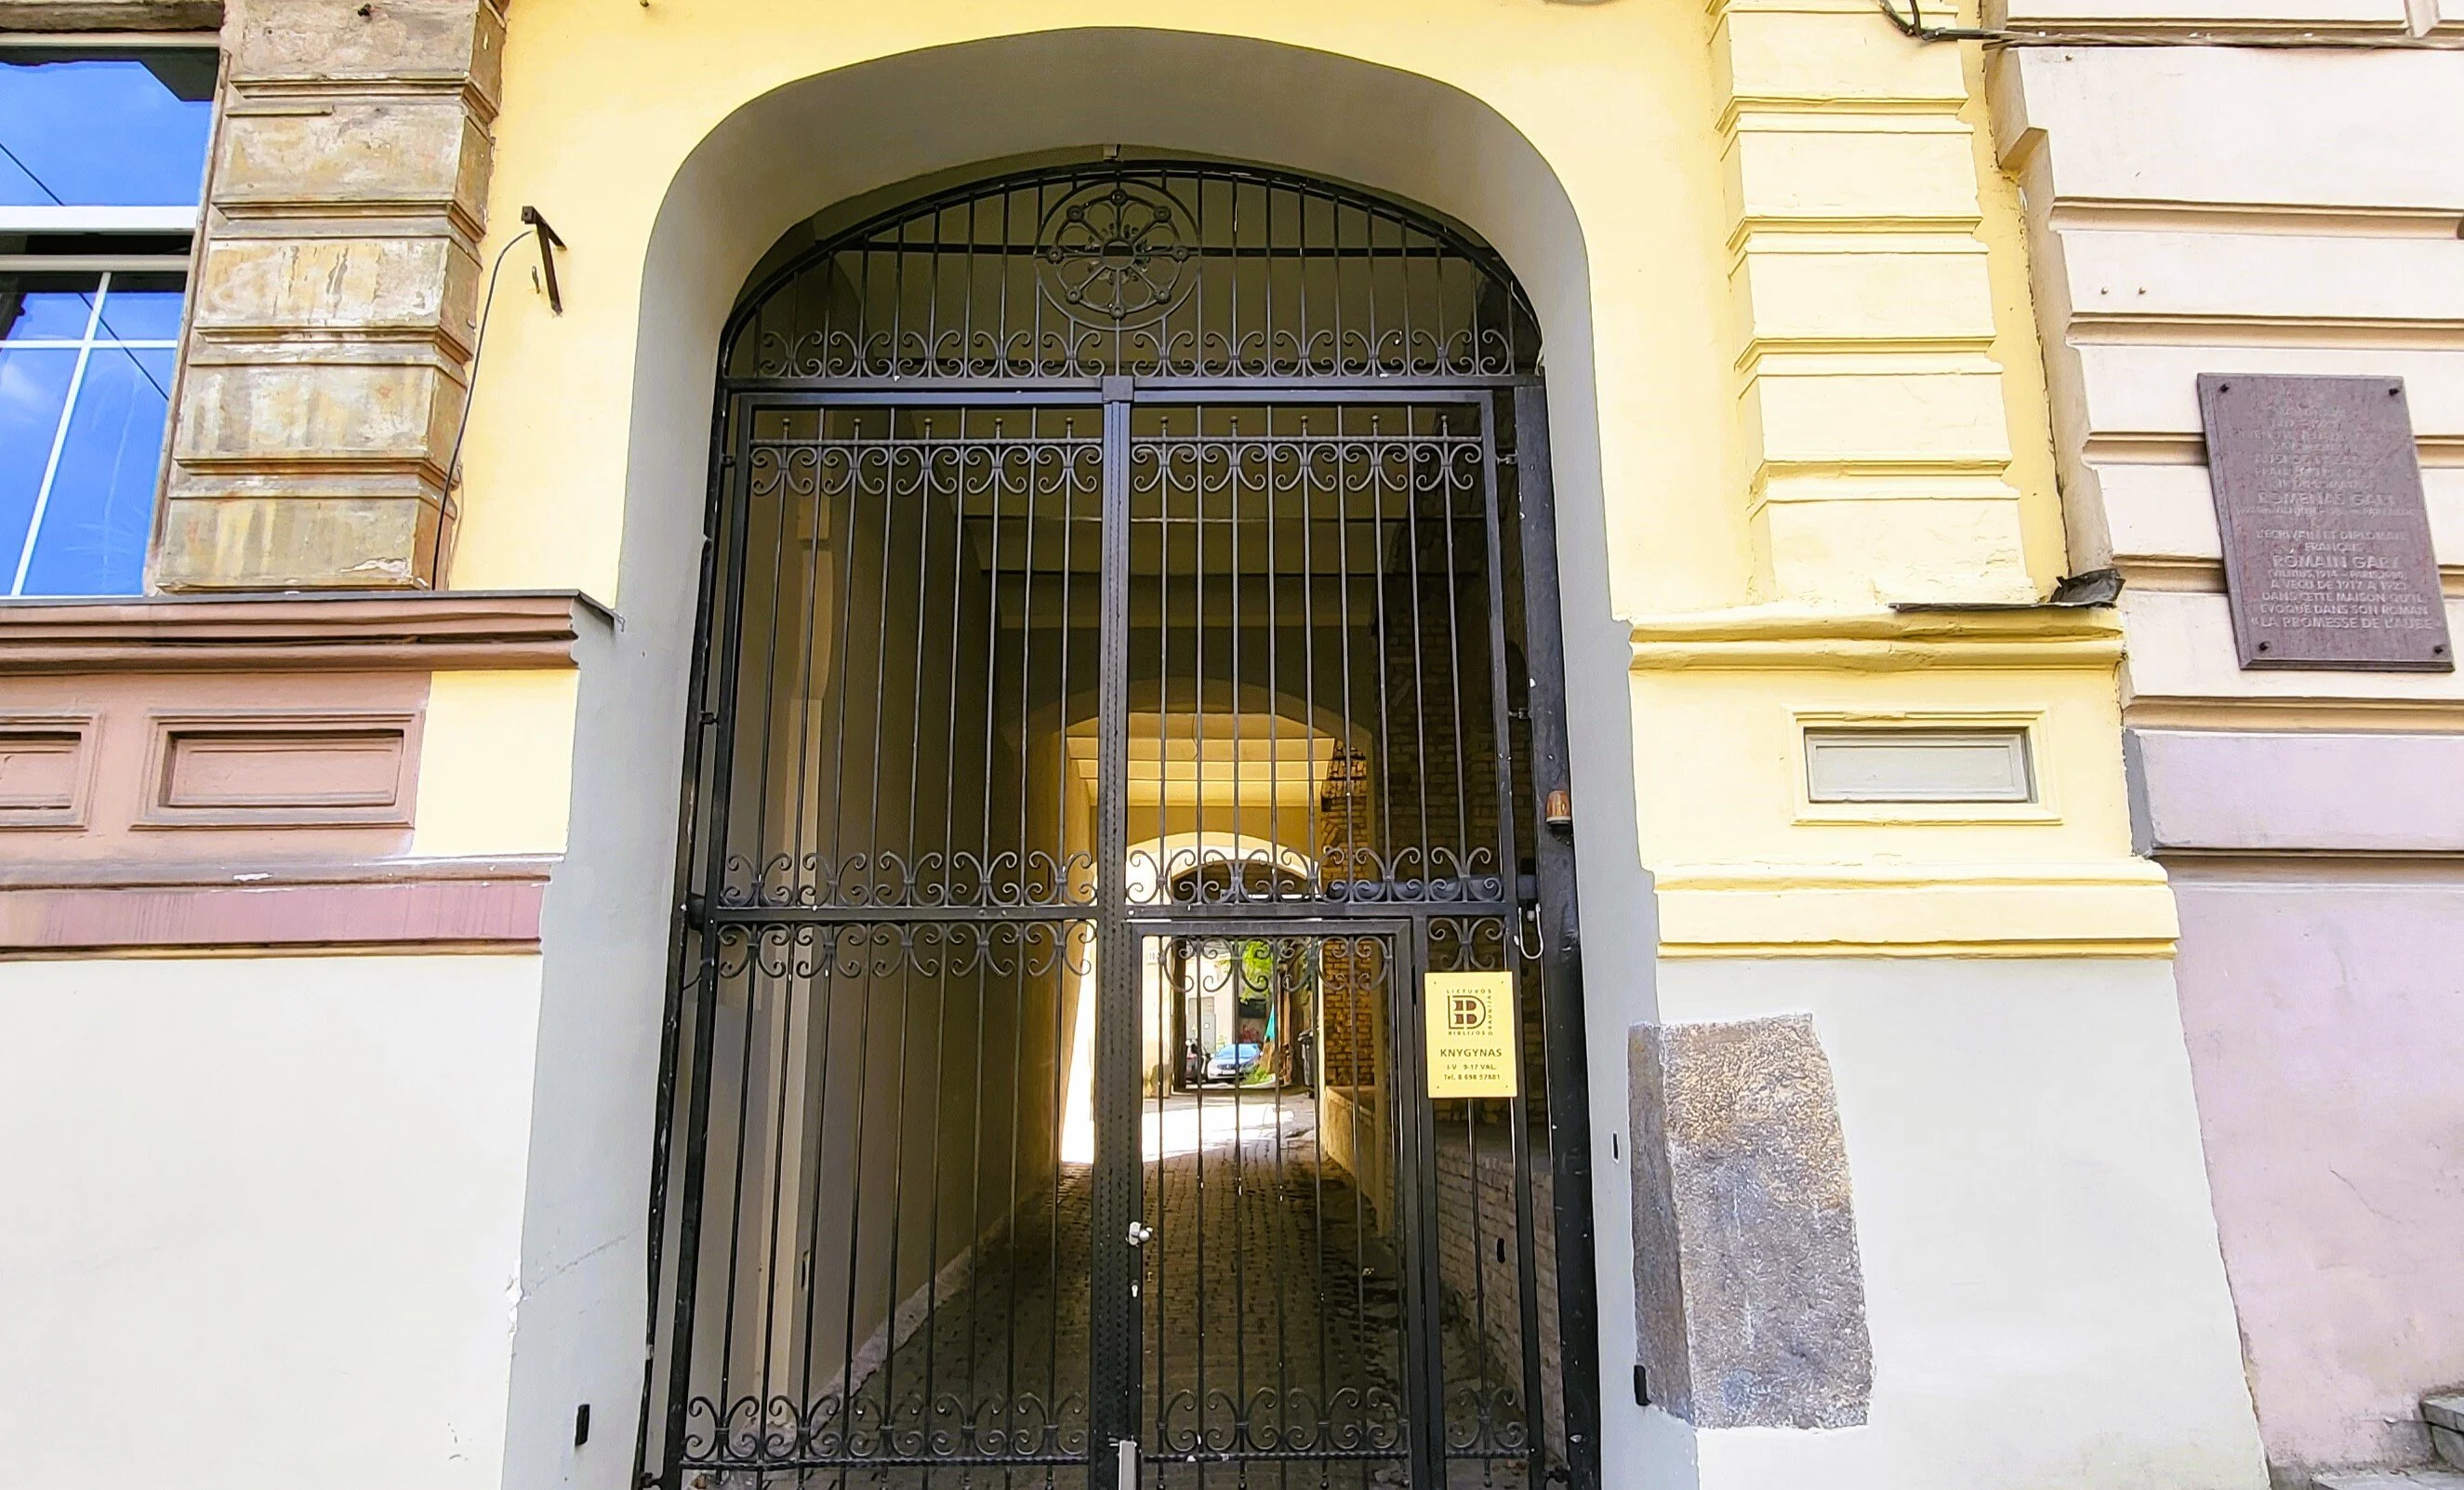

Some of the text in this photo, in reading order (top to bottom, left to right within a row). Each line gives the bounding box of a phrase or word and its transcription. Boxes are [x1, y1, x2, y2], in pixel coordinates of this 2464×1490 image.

[2262, 592, 2297, 601] DANS
[2336, 592, 2386, 602] MAISON
[2361, 618, 2379, 628] DE
[1440, 1048, 1503, 1058] KNYGYNAS
